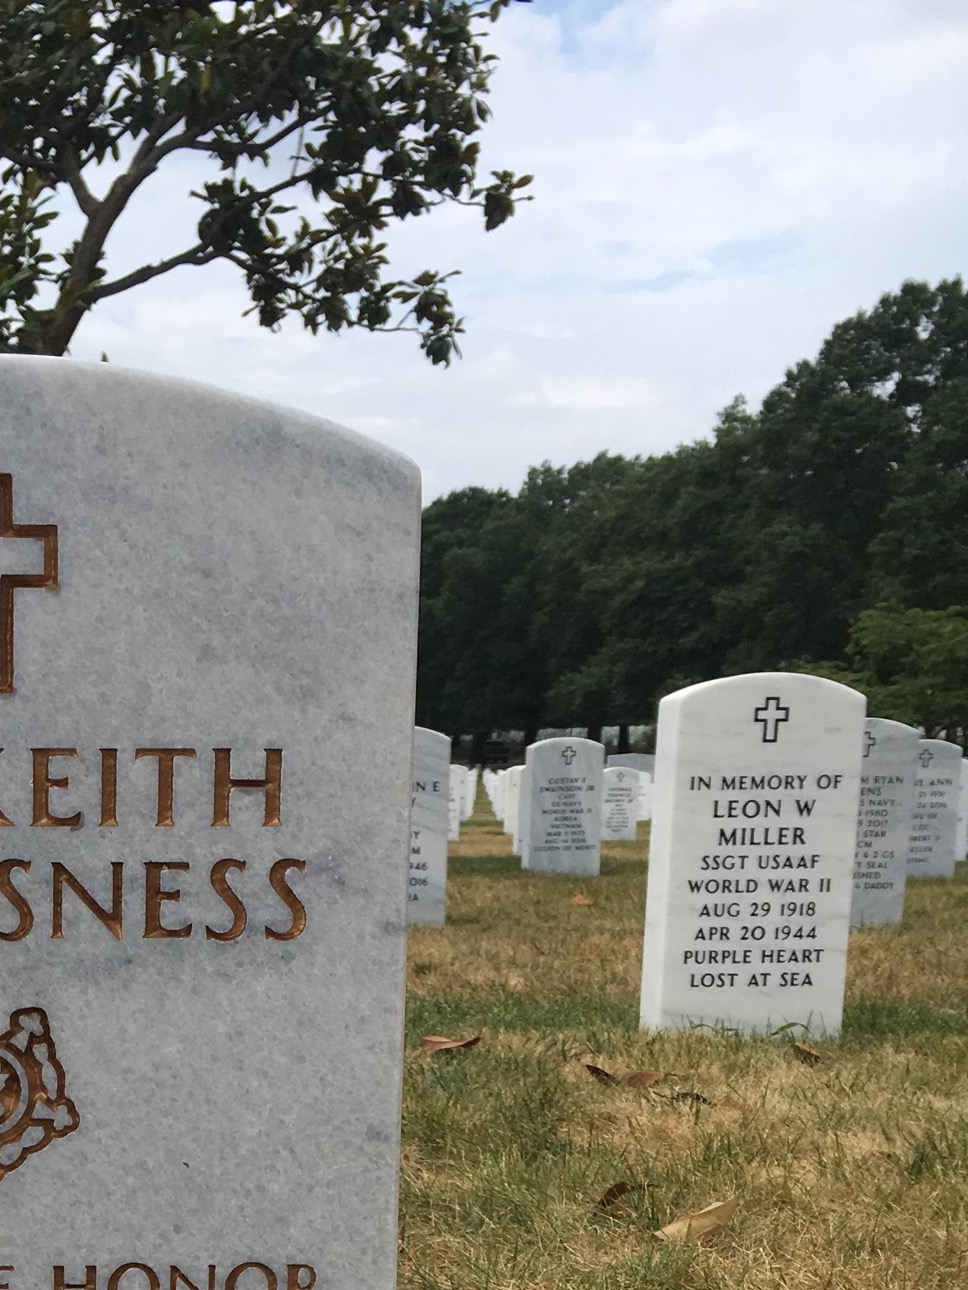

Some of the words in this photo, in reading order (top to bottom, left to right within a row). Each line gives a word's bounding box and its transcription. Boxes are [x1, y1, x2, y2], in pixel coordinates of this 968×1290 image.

[432, 781, 440, 792] E
[689, 776, 712, 790] IN
[721, 774, 808, 790] MEMORY
[816, 774, 843, 790] OF
[713, 799, 782, 818] LEON
[795, 799, 817, 817] W
[869, 799, 896, 807] NAVY
[718, 827, 806, 846] MILLER
[700, 855, 749, 871] SSGT
[758, 854, 821, 870] USAAF
[687, 879, 759, 894] WORLD
[768, 878, 810, 893] WAR
[819, 878, 832, 893] II
[699, 902, 741, 918] AUG
[750, 902, 771, 917] 29
[780, 901, 816, 917] 1918
[694, 926, 731, 941] APR
[740, 925, 766, 941] 20
[774, 925, 818, 940] 1944
[683, 950, 753, 965] PURPLE
[760, 949, 825, 964] HEART
[690, 973, 738, 988] LOST
[747, 973, 771, 987] AT
[779, 972, 813, 987] SEA
